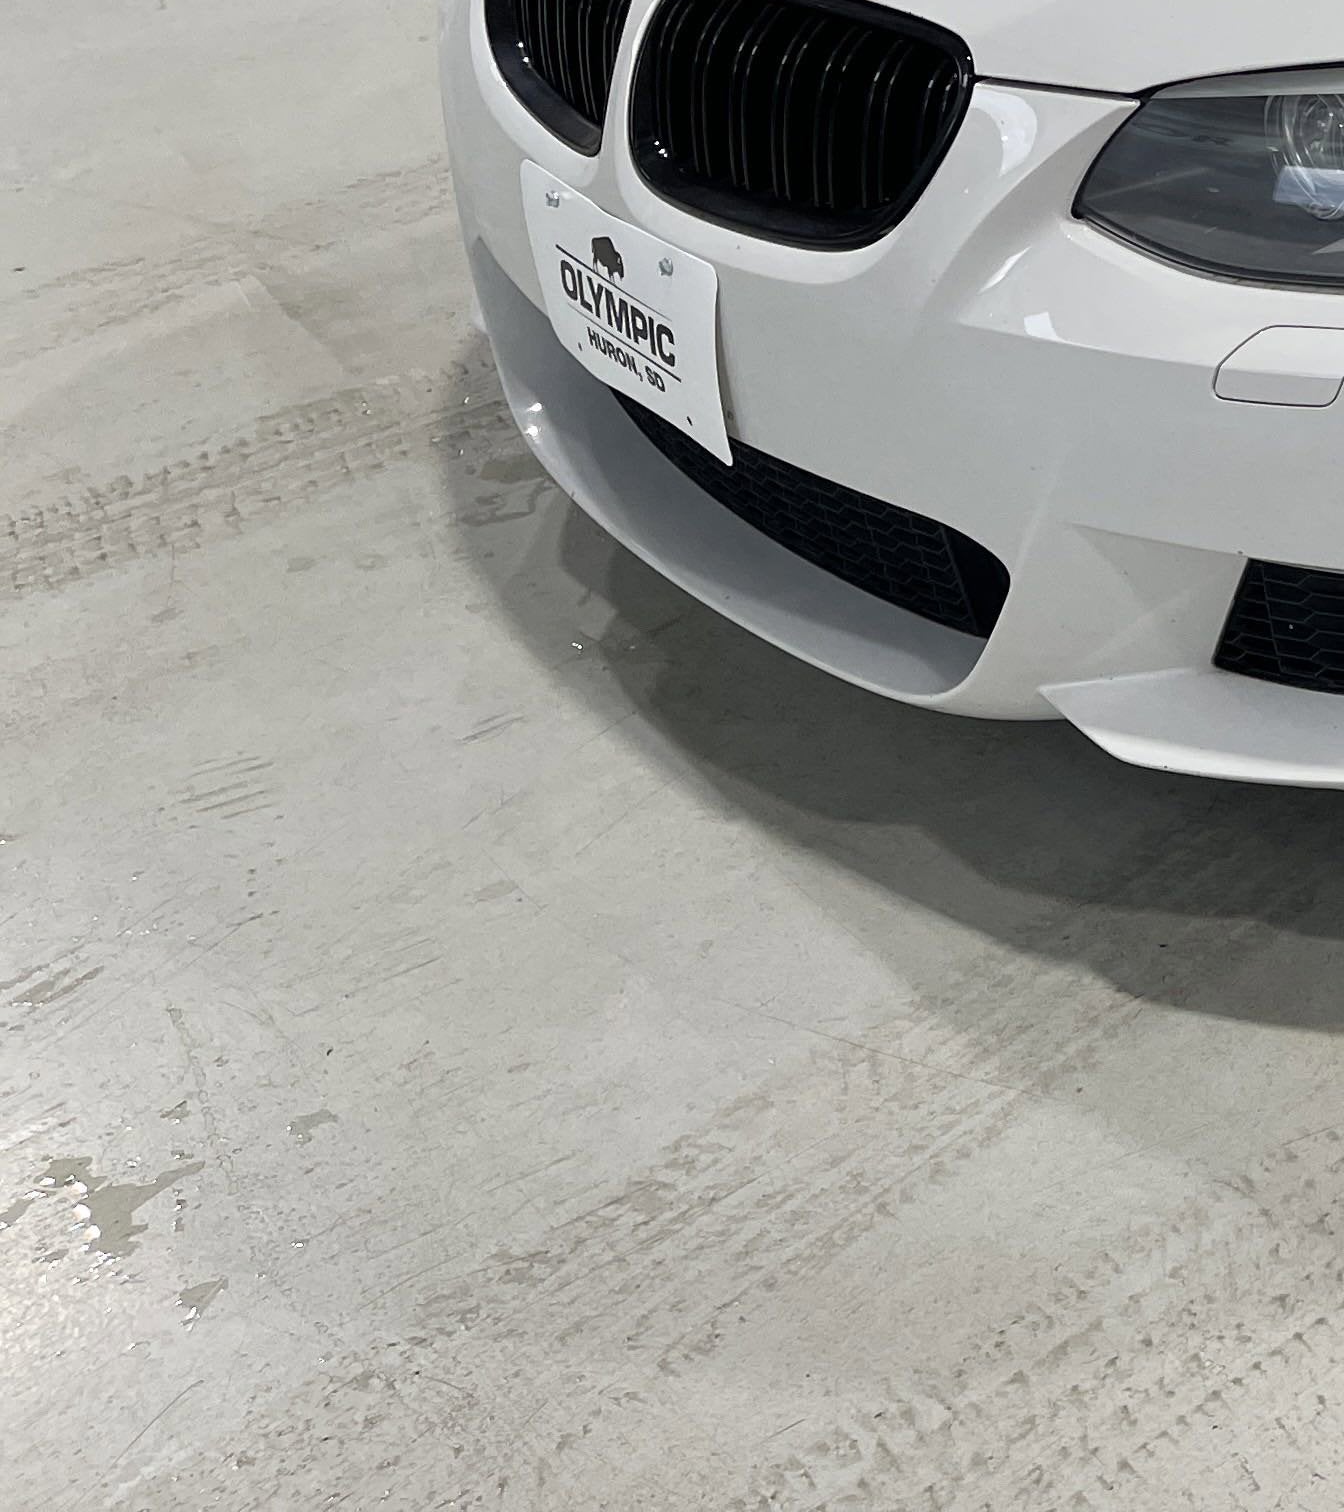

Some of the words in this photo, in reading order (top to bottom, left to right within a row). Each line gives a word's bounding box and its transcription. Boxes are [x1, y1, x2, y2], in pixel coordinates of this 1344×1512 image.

[561, 259, 676, 366] OLYMPIC
[587, 326, 644, 382] HURON,
[644, 369, 666, 392] SD
